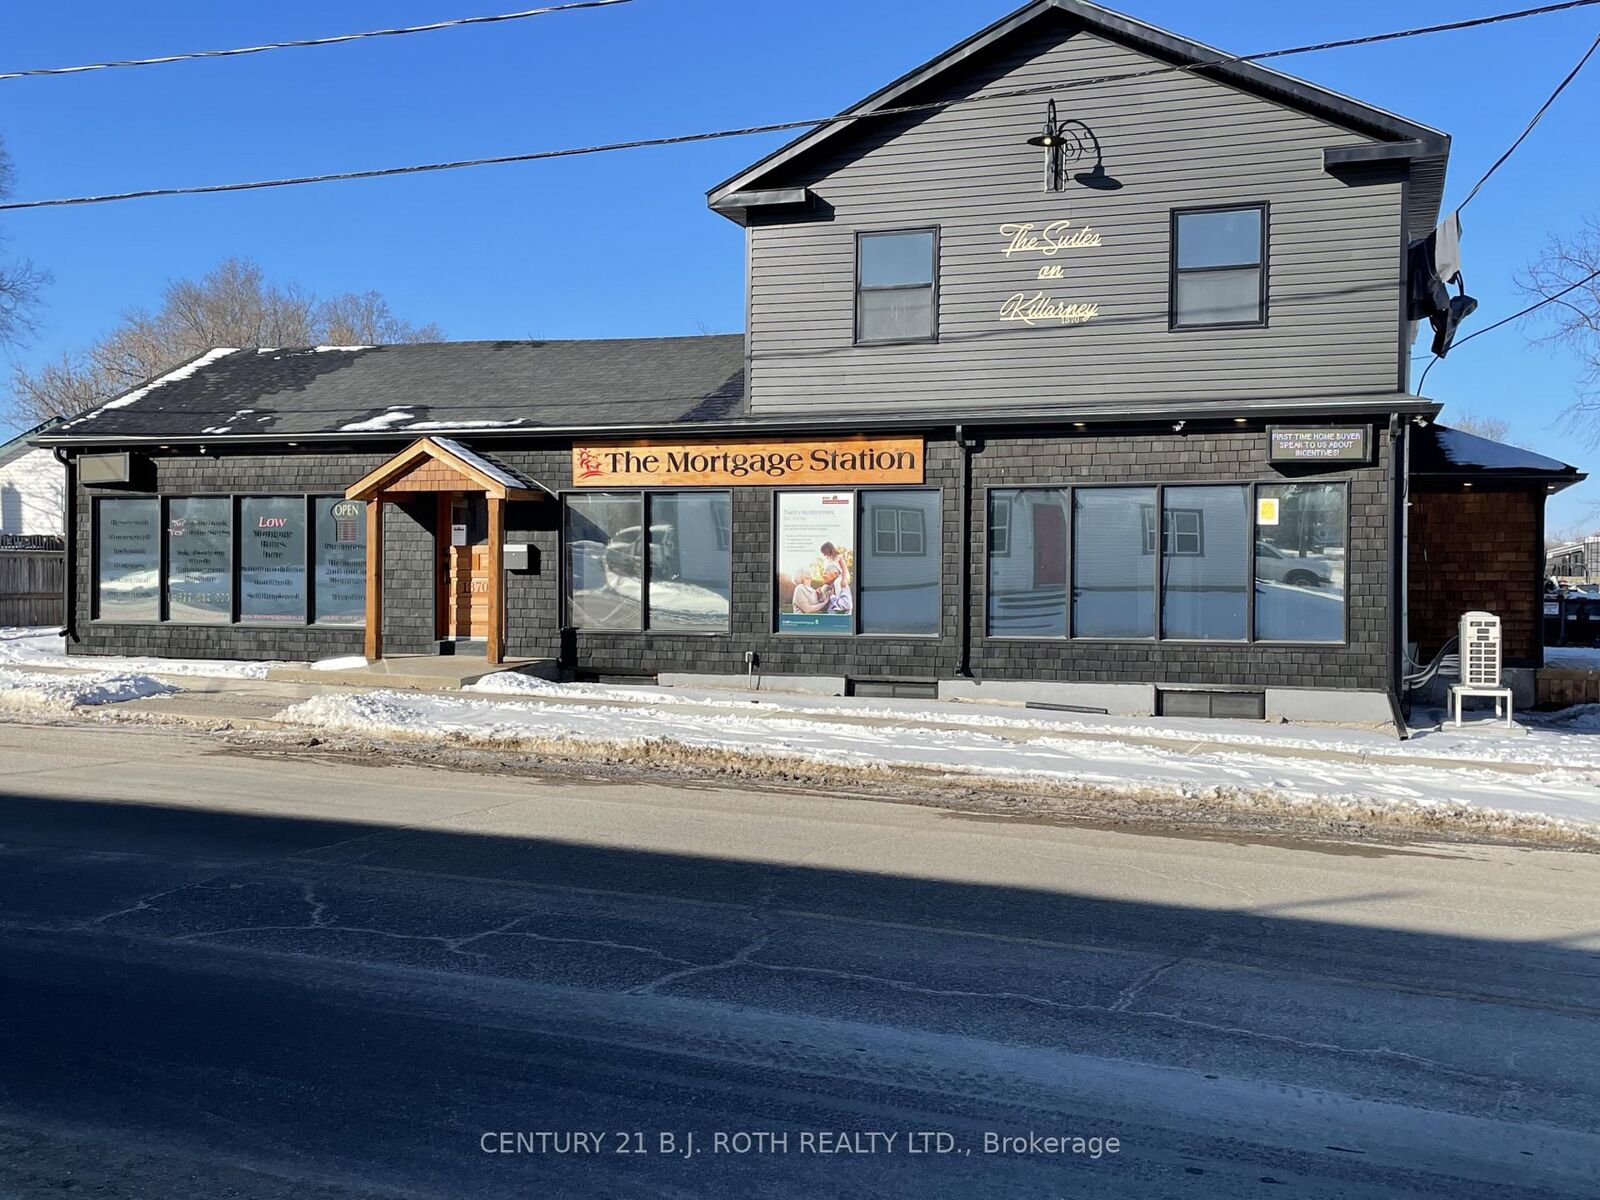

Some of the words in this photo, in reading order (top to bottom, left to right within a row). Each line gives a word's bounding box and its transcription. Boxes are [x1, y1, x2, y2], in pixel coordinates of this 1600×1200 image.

[1000, 224, 1039, 257] The
[1043, 220, 1102, 255] Suites
[1038, 265, 1064, 279] on
[1000, 292, 1099, 325] Killarney
[1337, 432, 1361, 440] BUYER
[1280, 441, 1303, 449] SPEAK
[1305, 441, 1315, 449] TO
[604, 451, 660, 473] The
[666, 451, 804, 477] Mortgage
[809, 448, 915, 472] Station
[334, 504, 359, 516] OPEN
